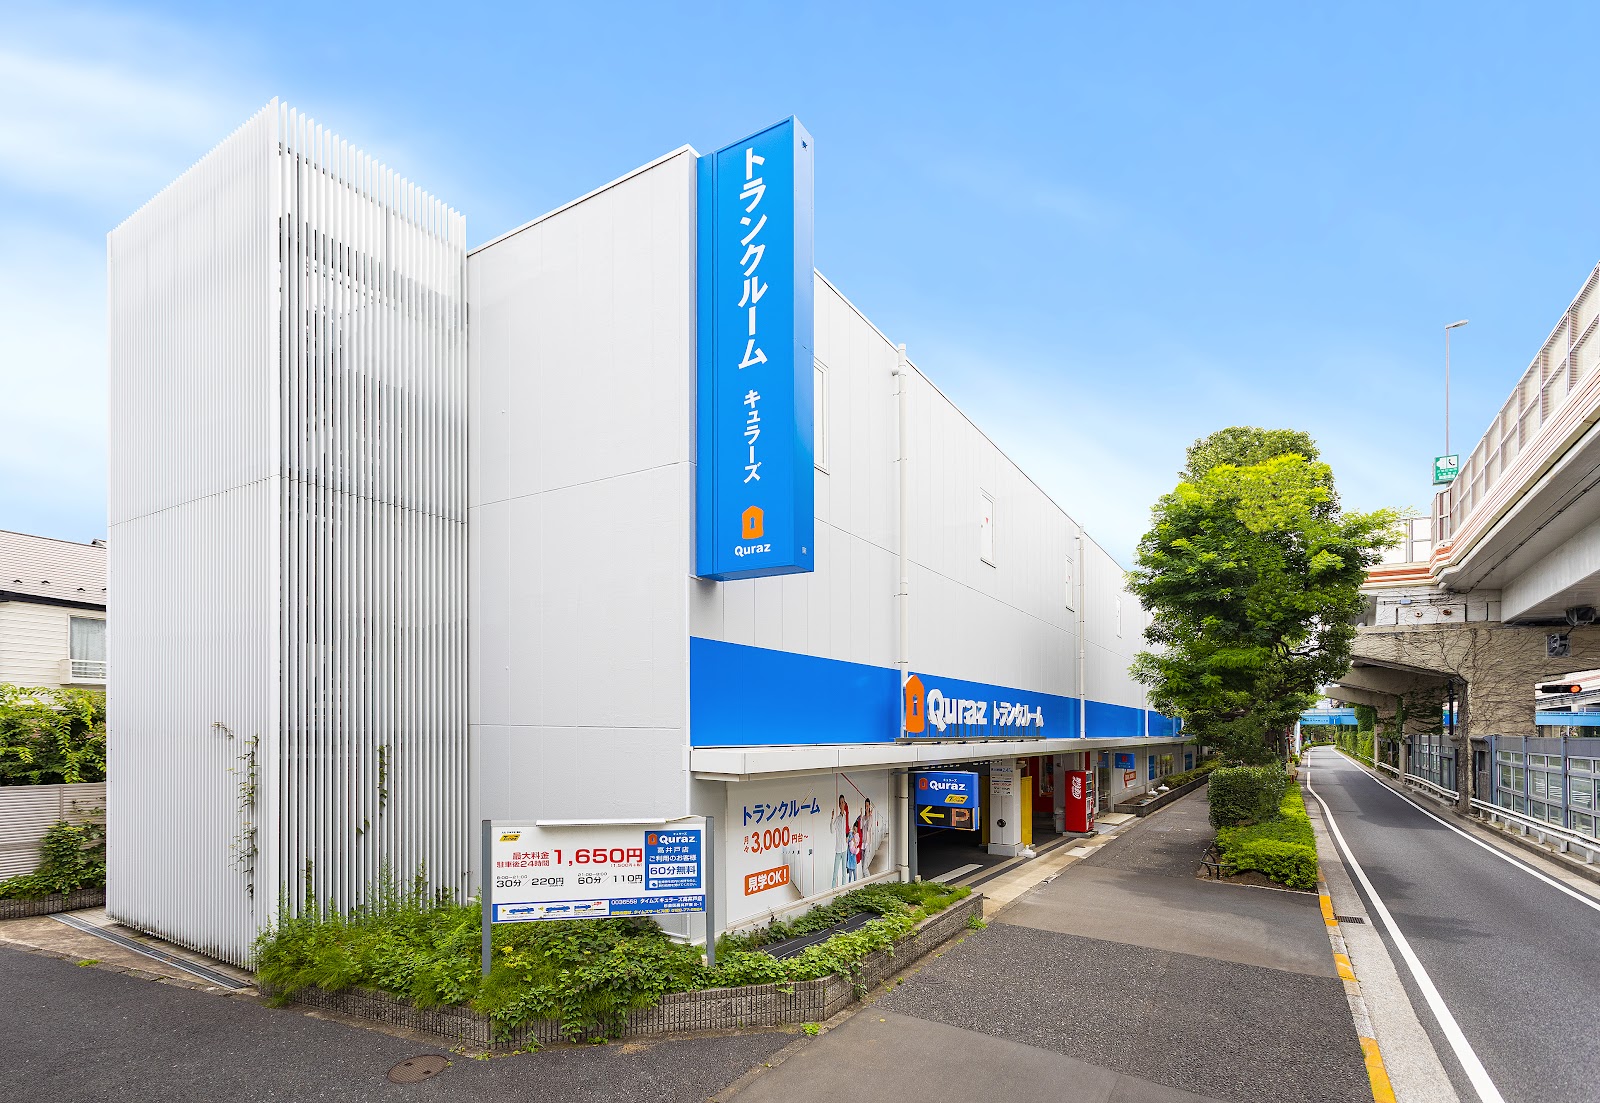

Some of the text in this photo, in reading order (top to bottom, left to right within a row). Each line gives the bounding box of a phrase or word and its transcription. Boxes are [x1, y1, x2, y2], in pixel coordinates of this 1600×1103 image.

[737, 147, 769, 371] トランクルーム
[743, 388, 762, 484] キュラーズ
[734, 541, 772, 558] Quraz
[926, 688, 1044, 732] Quraz トランクルーム
[929, 780, 966, 791] Quraz
[743, 797, 821, 826] トランクルーム
[951, 807, 971, 827] P
[659, 835, 696, 845] Quraz
[496, 860, 550, 868] 駐車後24時間
[512, 852, 550, 860] 最大料金
[553, 847, 643, 867] 1,650円
[650, 865, 696, 875] 60分無料
